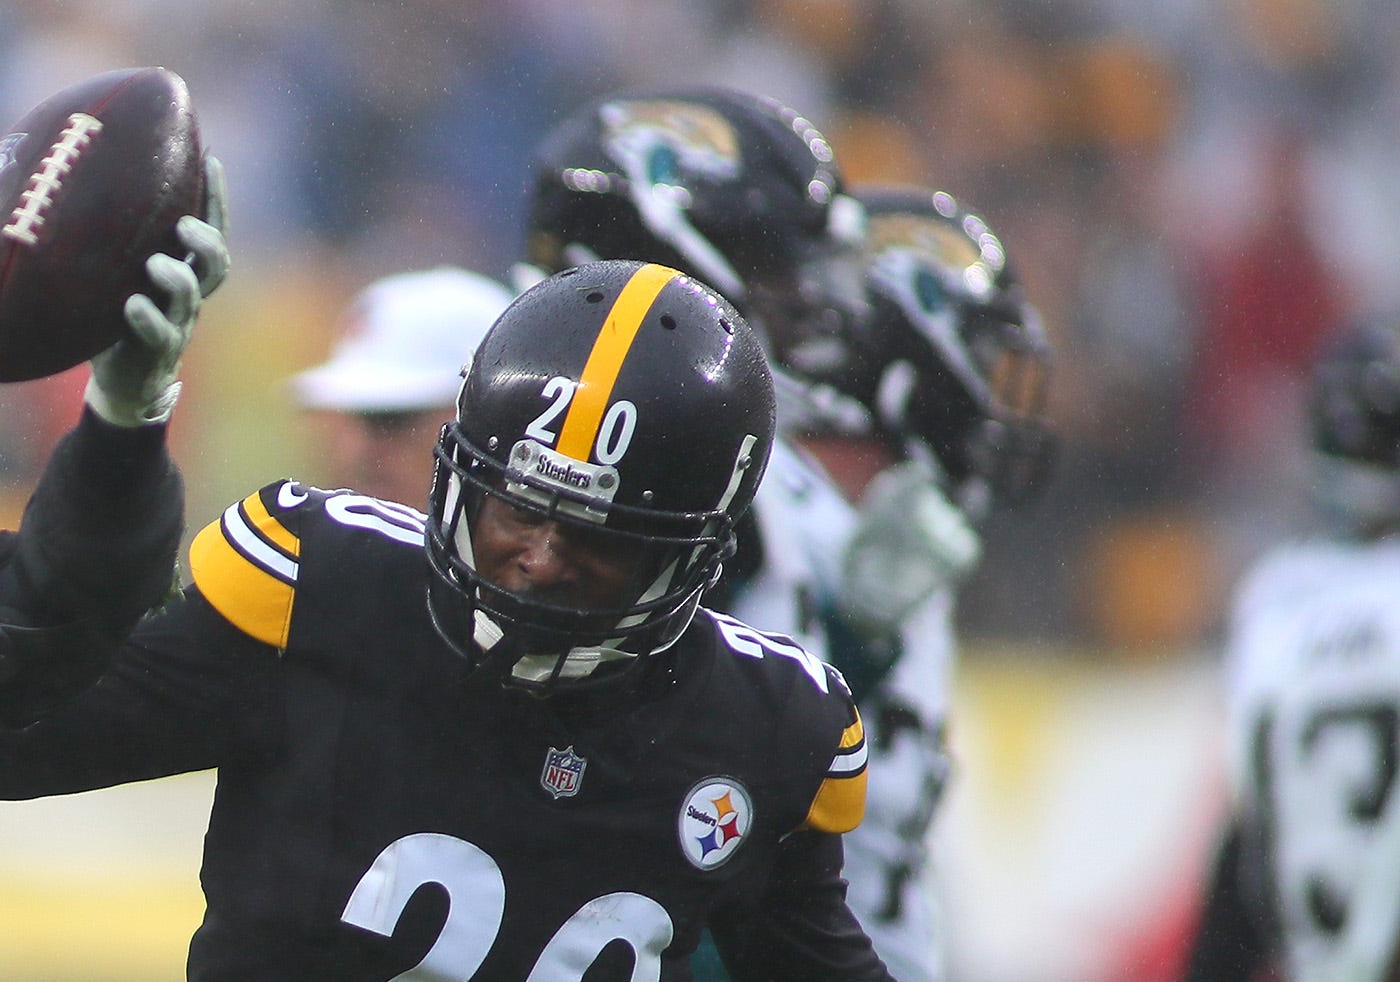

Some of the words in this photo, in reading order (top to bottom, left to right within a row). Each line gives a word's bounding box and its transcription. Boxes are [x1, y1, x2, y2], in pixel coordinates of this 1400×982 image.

[525, 376, 638, 465] 20
[537, 454, 591, 489] Steelers
[547, 766, 575, 790] NFL
[687, 804, 717, 827] Steelers
